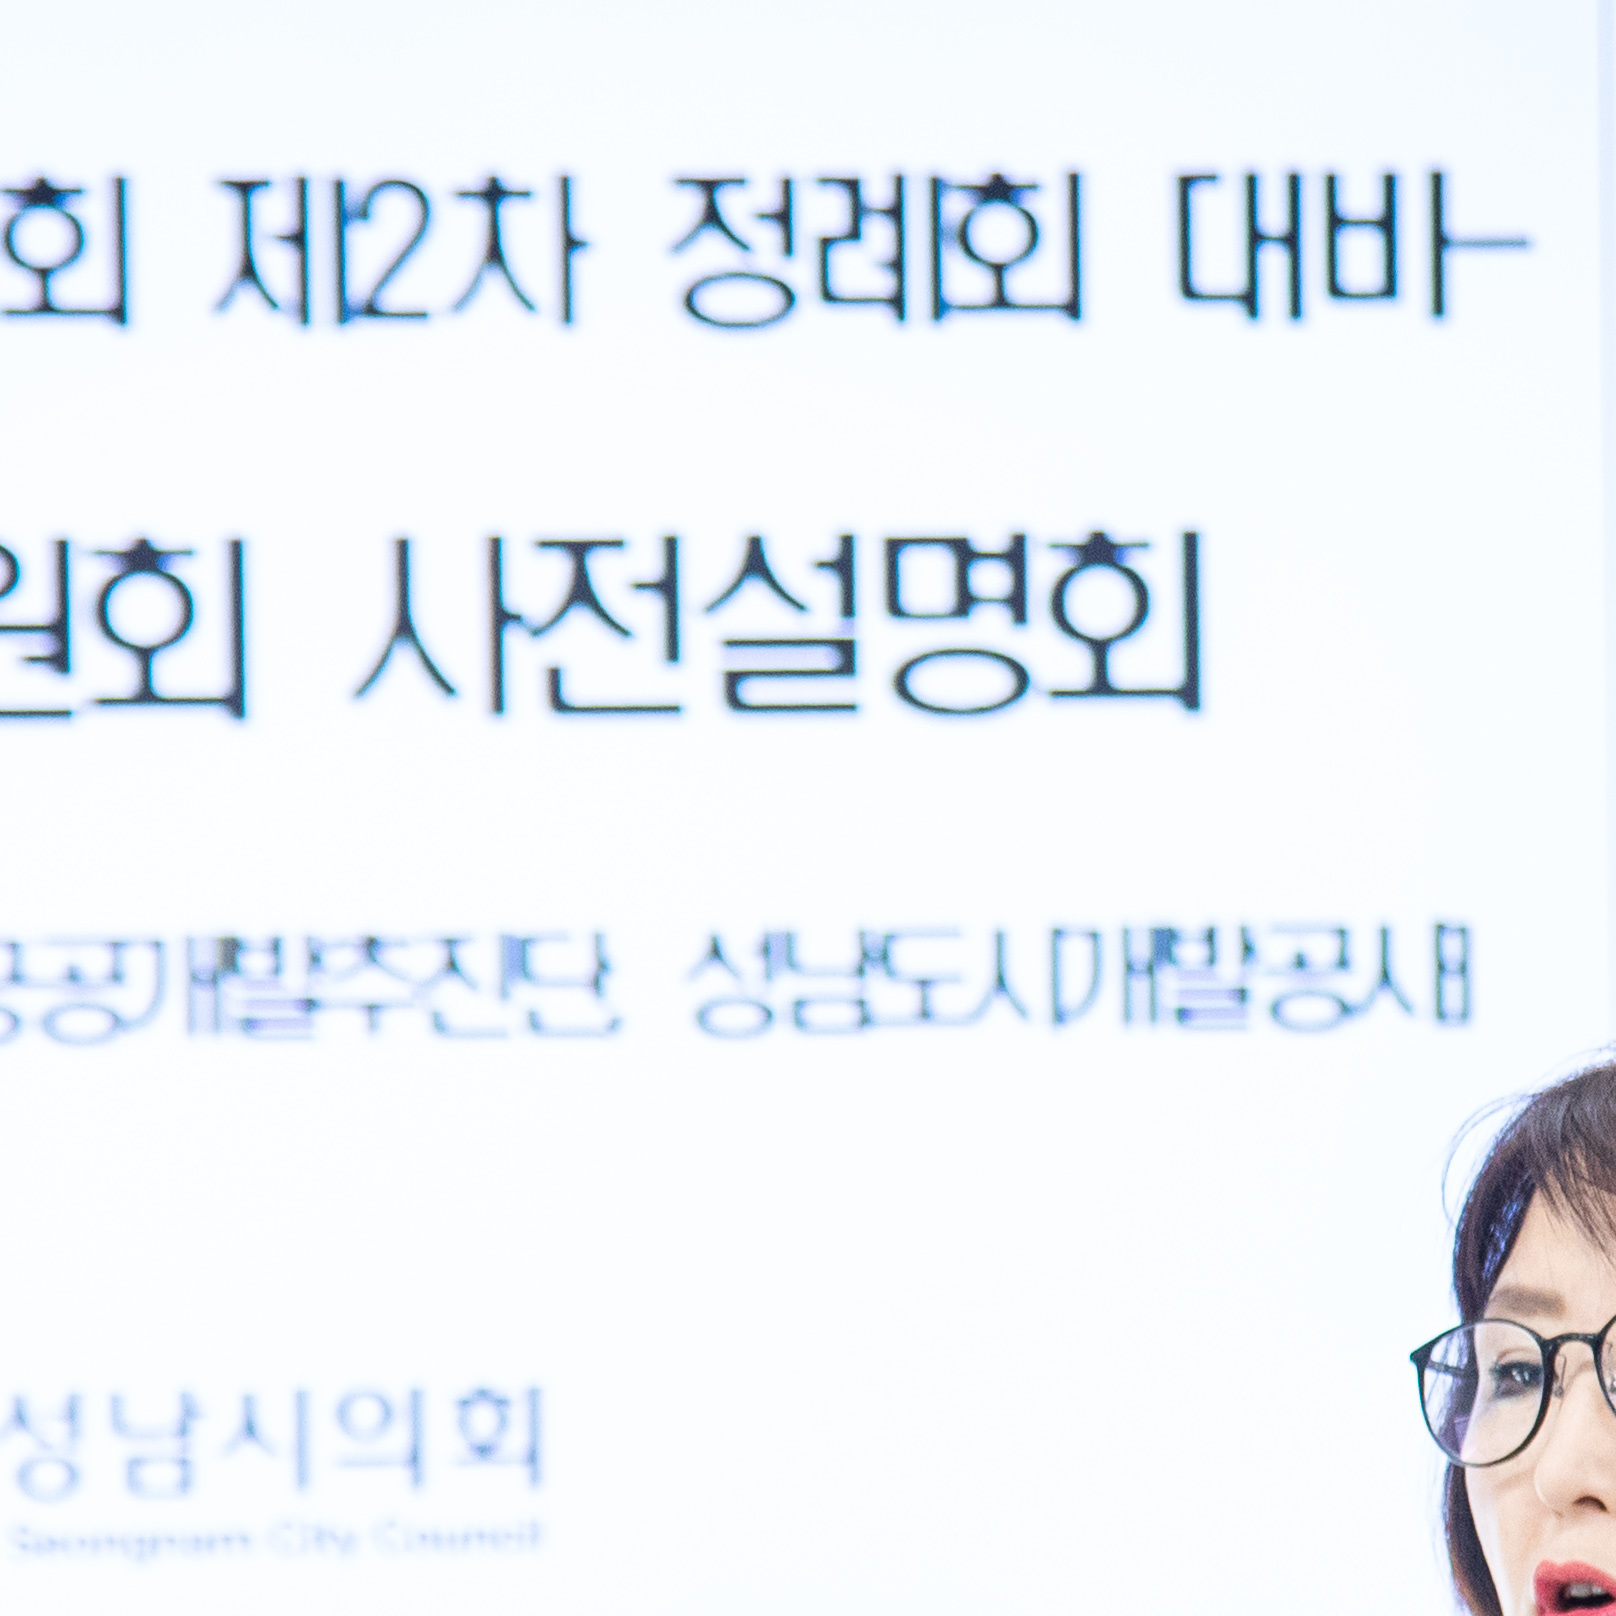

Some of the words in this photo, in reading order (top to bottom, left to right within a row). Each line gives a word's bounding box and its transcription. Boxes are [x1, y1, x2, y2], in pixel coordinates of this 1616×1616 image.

[216, 174, 592, 328] 제2차
[672, 172, 1084, 330] 정례회
[354, 529, 1204, 718] 사전설명회
